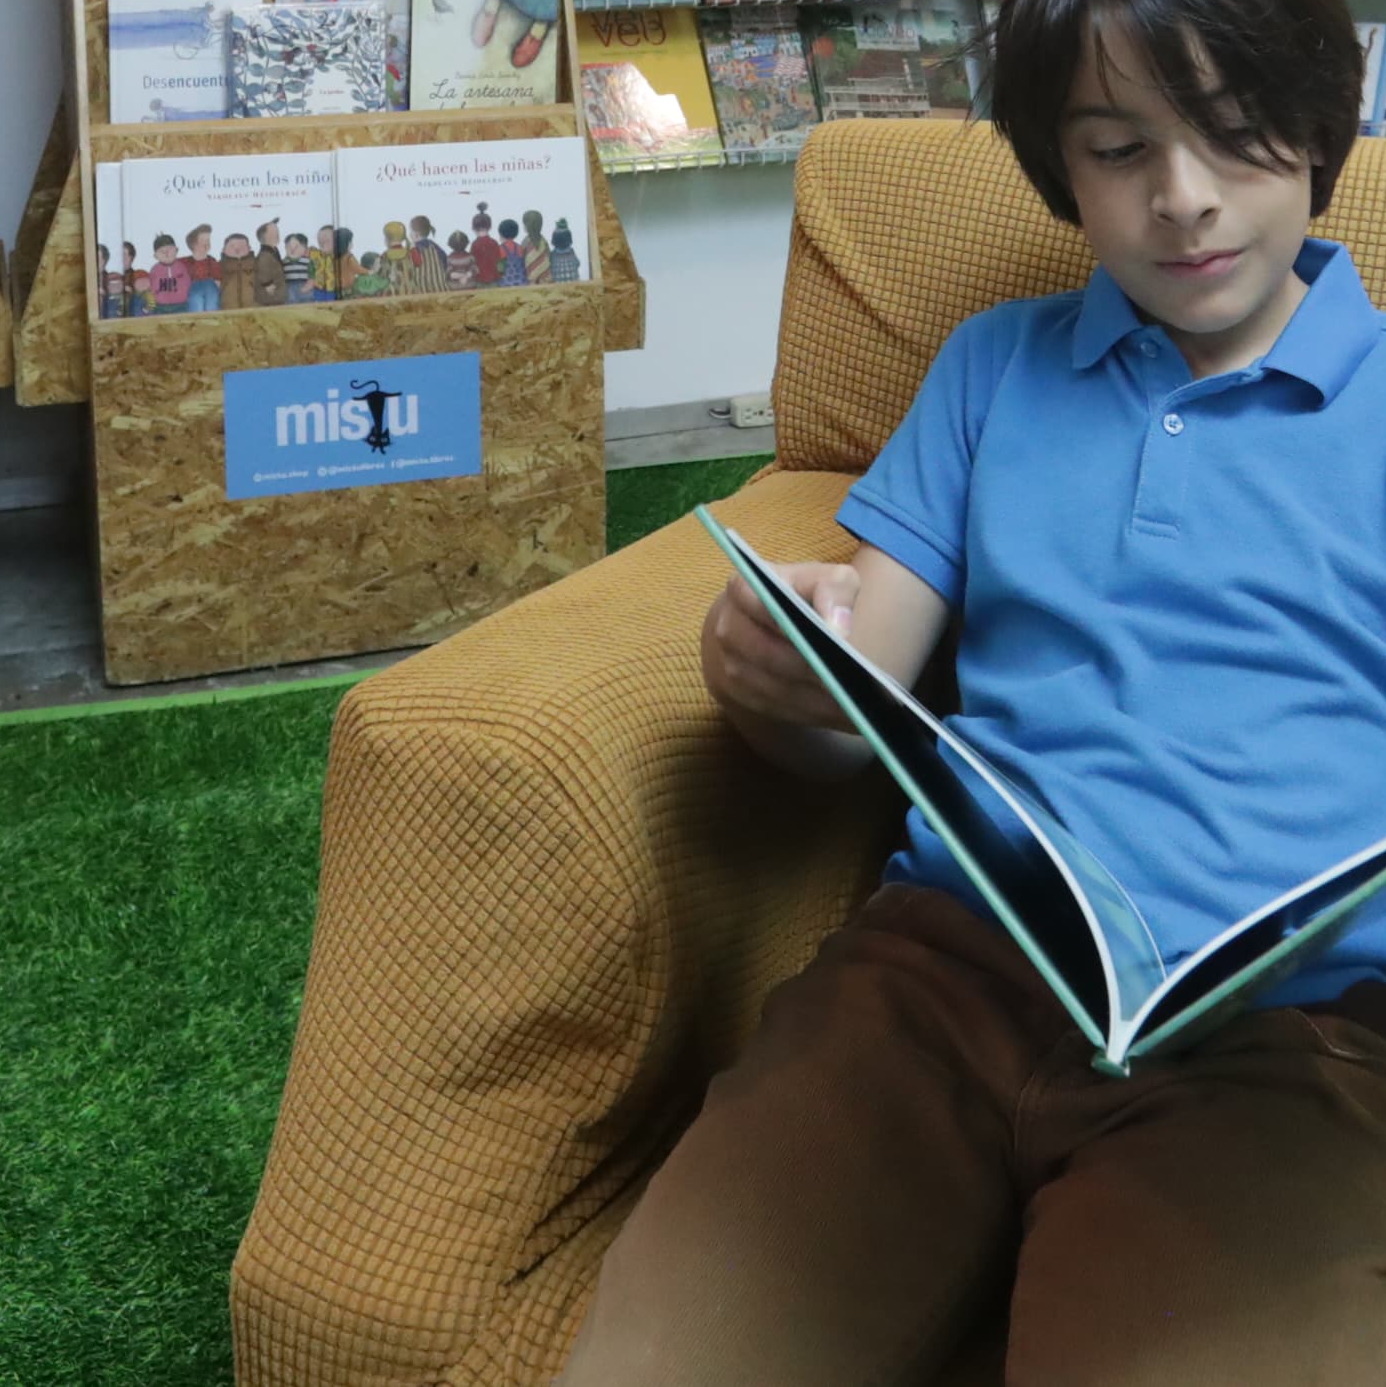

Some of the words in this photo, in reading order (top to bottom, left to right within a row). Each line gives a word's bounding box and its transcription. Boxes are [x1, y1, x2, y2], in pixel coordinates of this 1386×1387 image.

[429, 82, 457, 100] La
[375, 160, 416, 183] ¿Qué
[423, 160, 468, 177] hacen
[475, 158, 496, 175] las
[503, 155, 552, 173] niñas?
[163, 173, 206, 195] ¿Qué
[212, 172, 260, 188] hacen
[266, 171, 290, 186] los
[297, 170, 331, 184] niño
